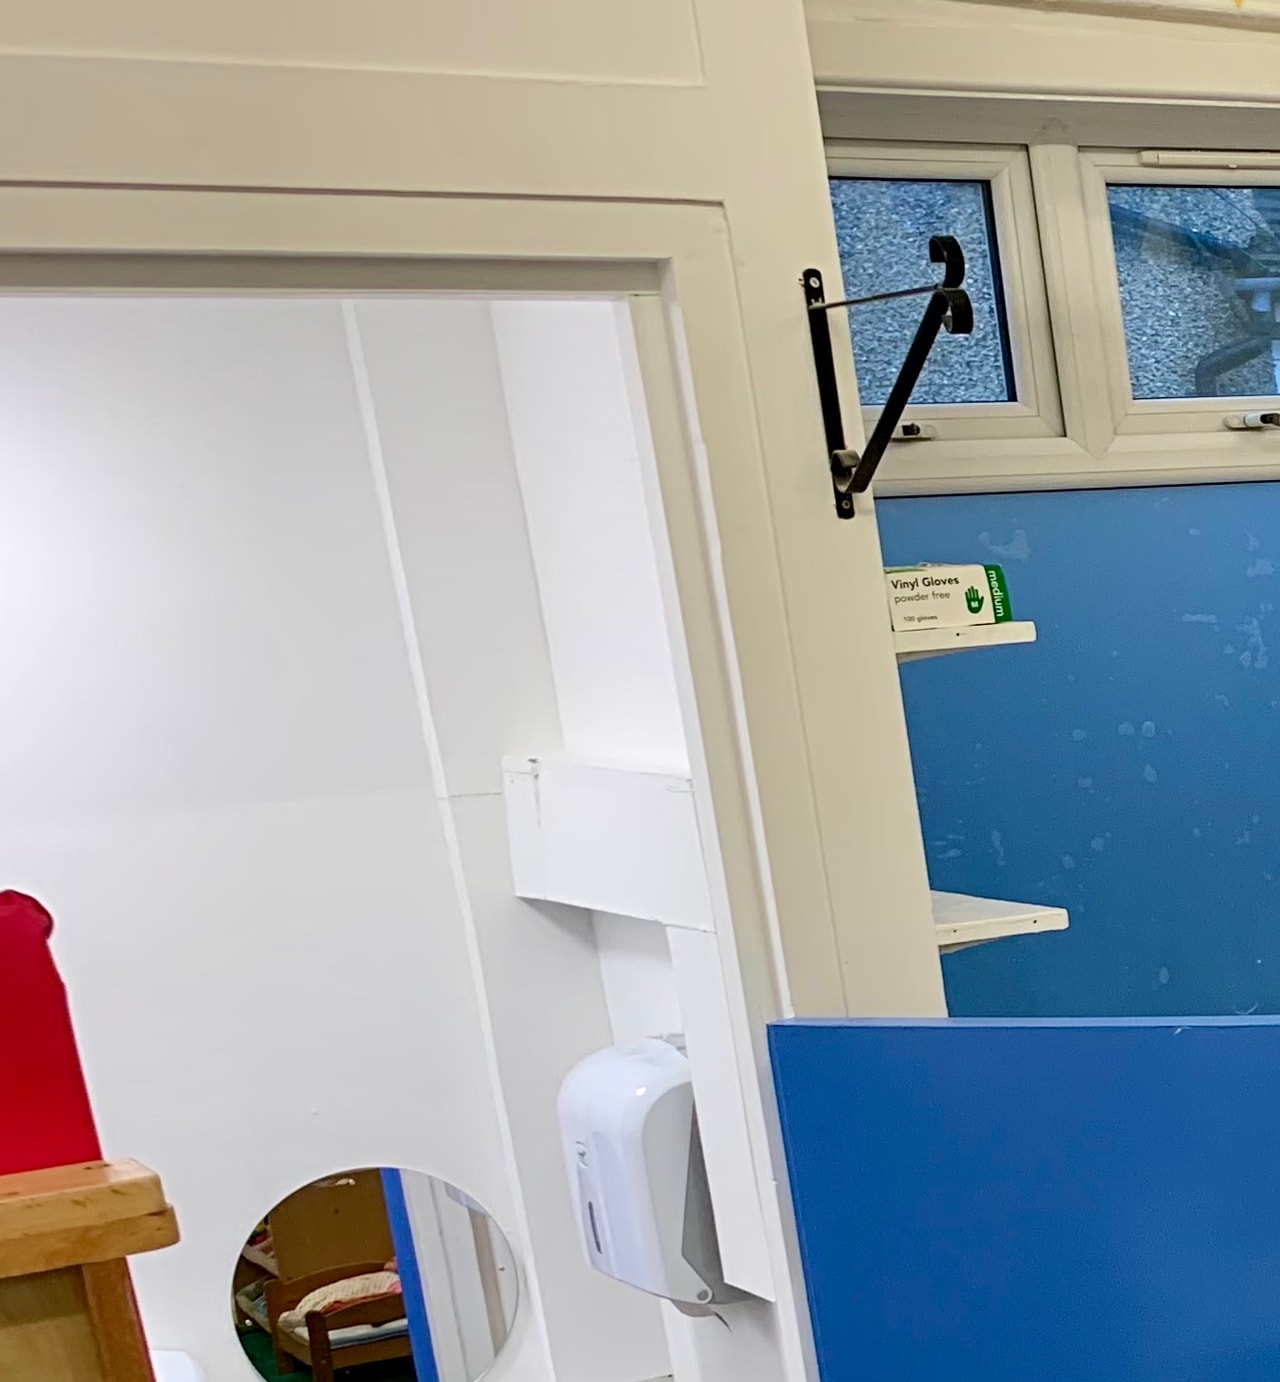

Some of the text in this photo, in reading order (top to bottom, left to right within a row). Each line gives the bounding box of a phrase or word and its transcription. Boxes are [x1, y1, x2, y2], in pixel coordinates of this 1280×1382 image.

[891, 576, 960, 591] Vinyl Gloves
[894, 591, 951, 605] powder free
[988, 570, 1004, 617] medium
